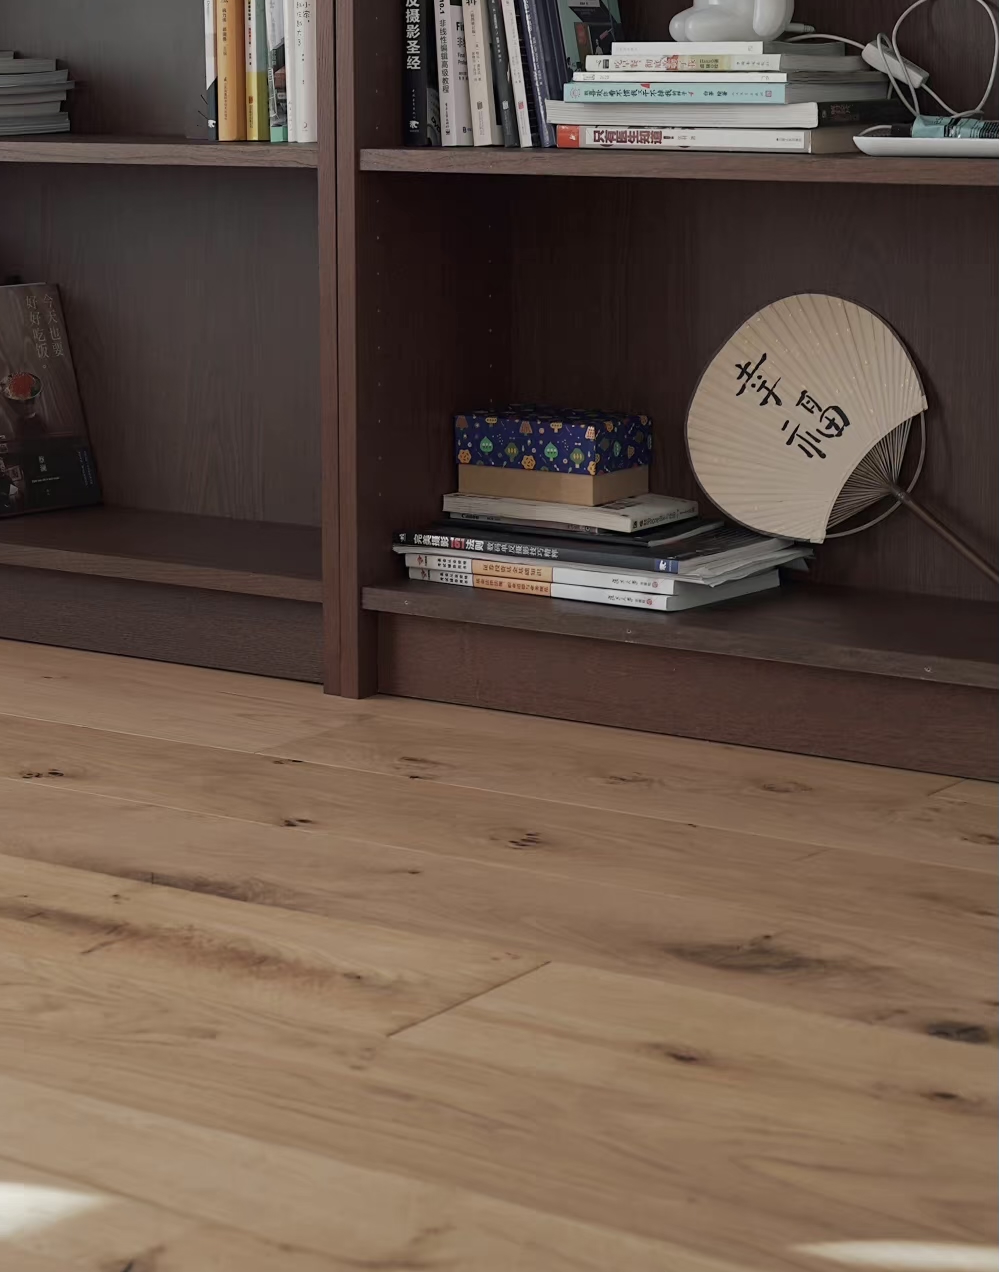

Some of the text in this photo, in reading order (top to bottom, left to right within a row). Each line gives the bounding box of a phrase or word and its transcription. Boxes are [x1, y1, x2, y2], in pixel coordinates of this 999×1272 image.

[439, 19, 450, 94] 非线性编辑高级教程
[593, 129, 663, 144] 只有医生知道
[43, 293, 65, 357] 今天也要
[735, 352, 851, 459] 幸福
[413, 533, 484, 552] 完美摄影161法则
